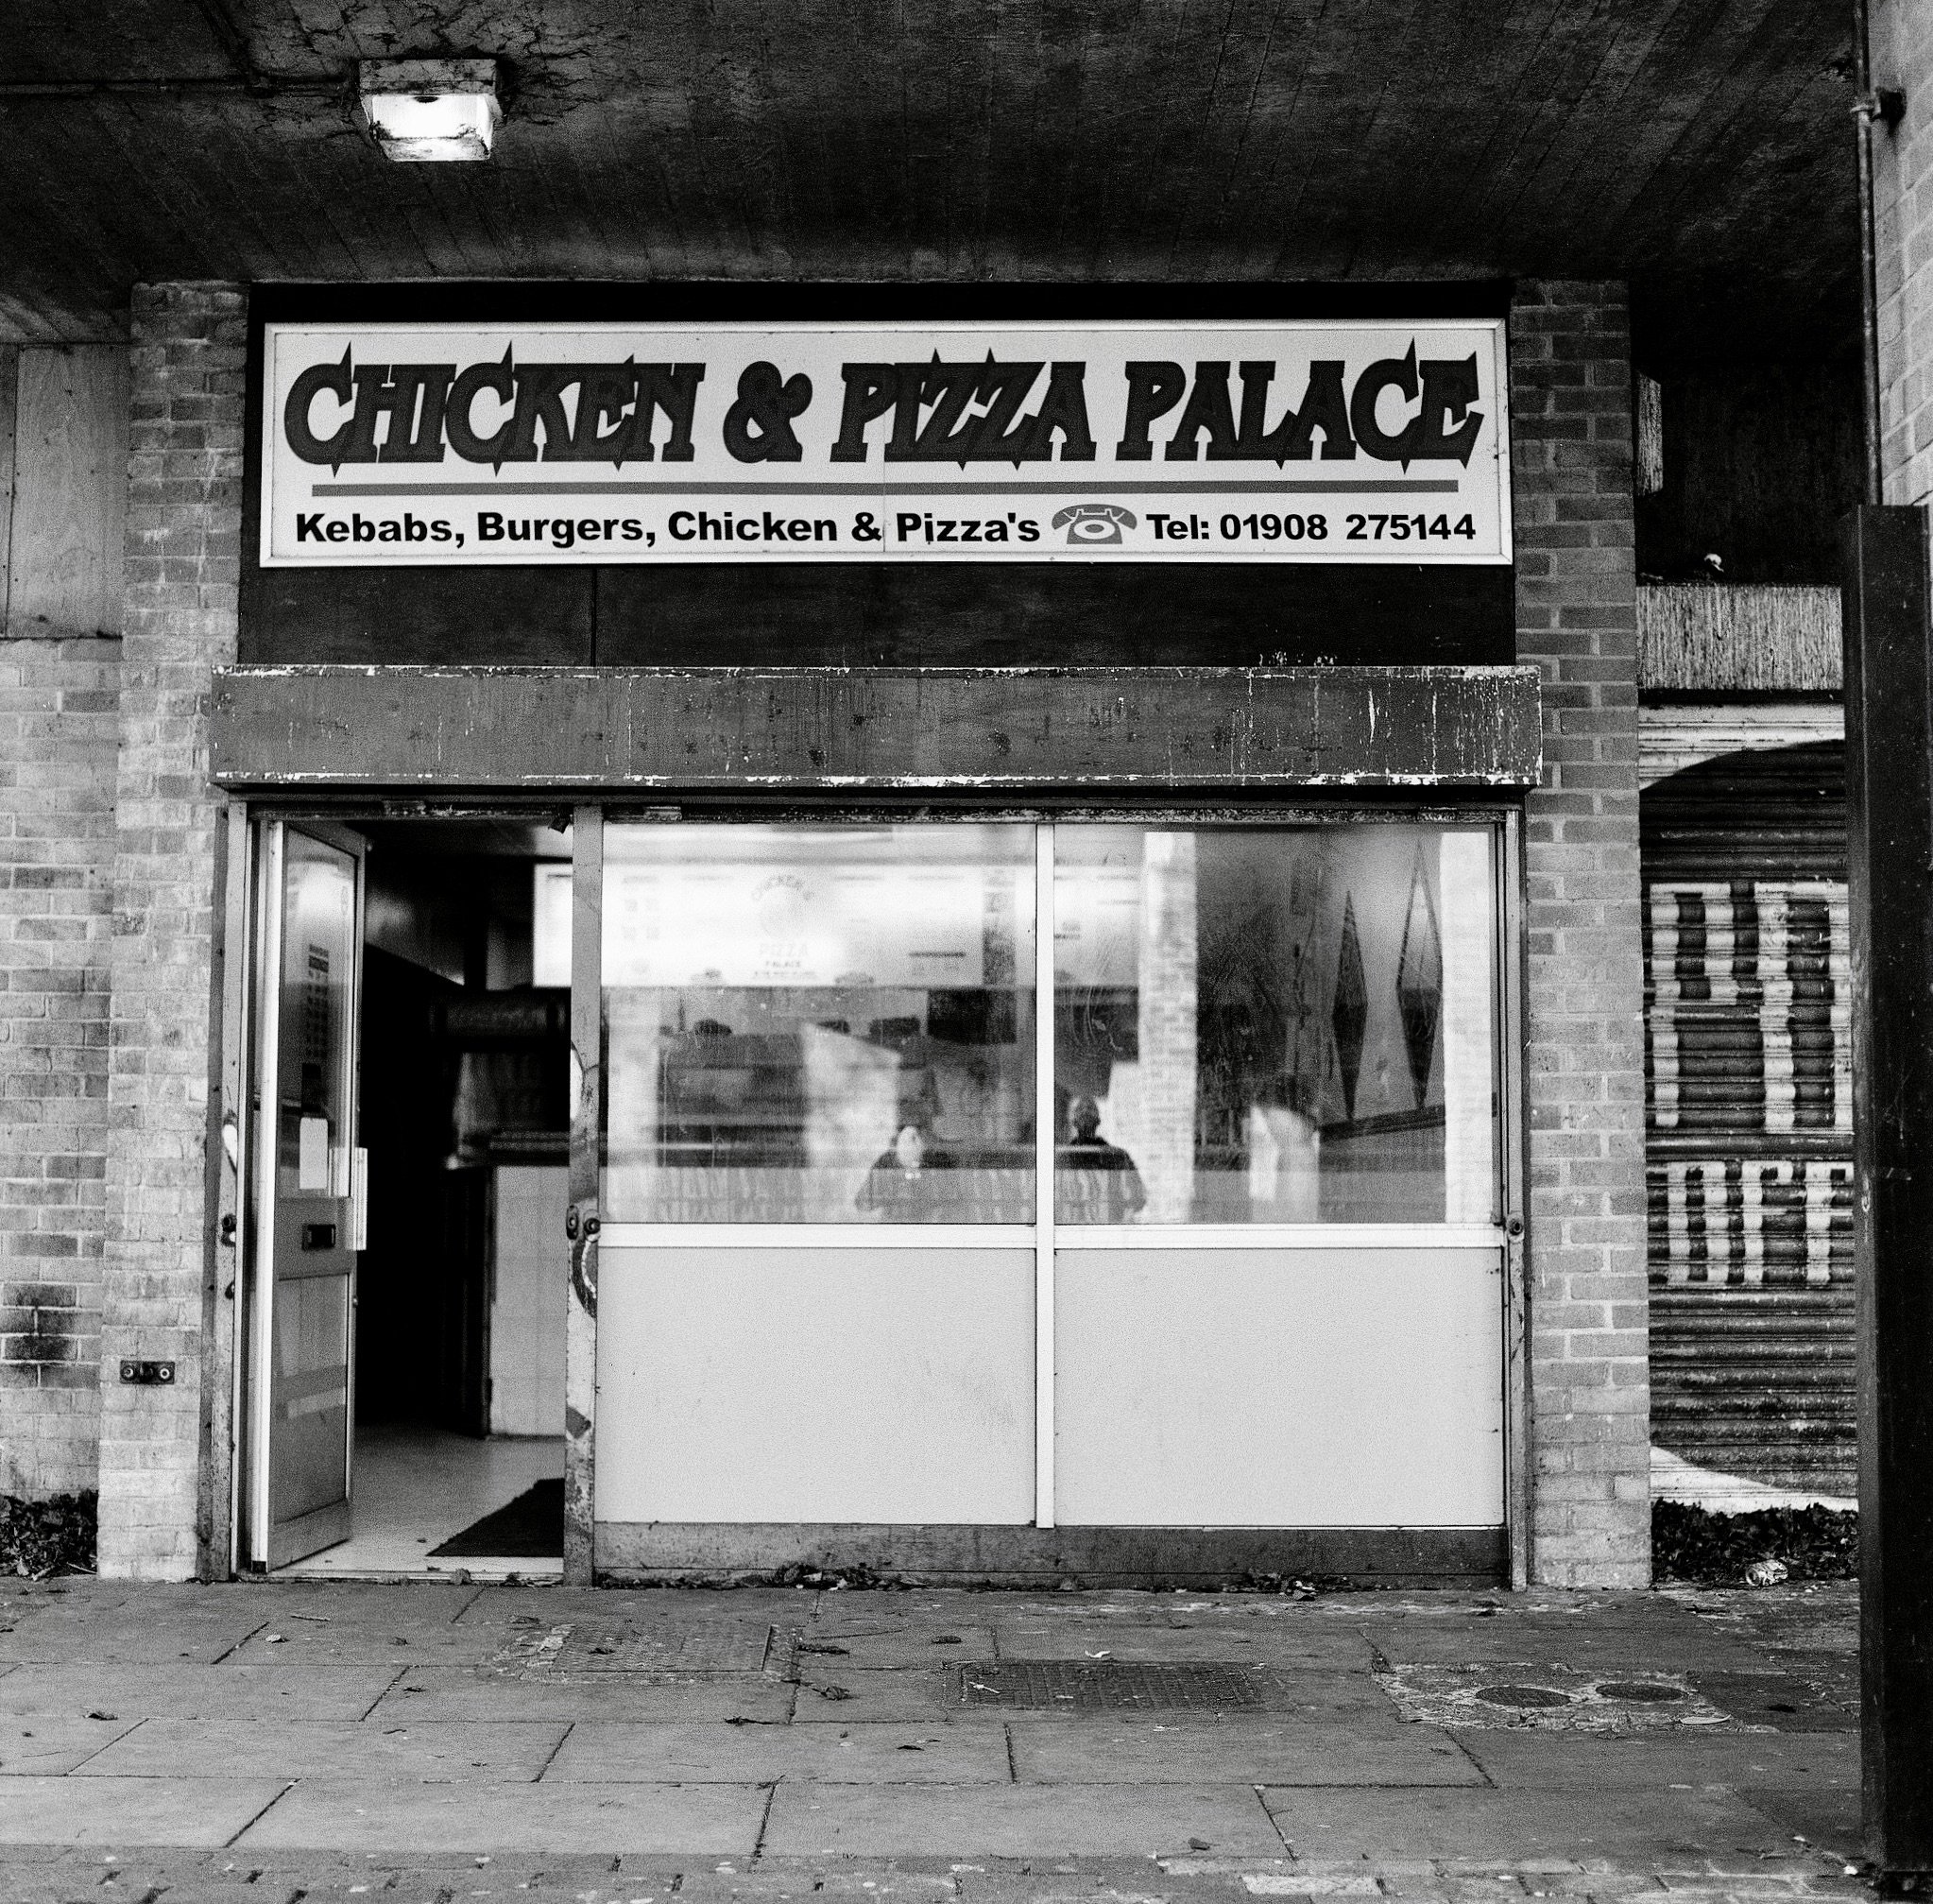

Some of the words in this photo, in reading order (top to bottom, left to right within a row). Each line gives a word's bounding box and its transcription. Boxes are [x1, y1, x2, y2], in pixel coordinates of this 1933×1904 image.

[284, 340, 707, 477] CHICKEN
[723, 361, 813, 464] &
[830, 348, 1097, 471] PIZZA
[1116, 337, 1484, 472] PALACE
[297, 512, 465, 548] Kebabs,
[477, 511, 656, 549] Burgers,
[668, 510, 837, 541] Chicken
[851, 511, 882, 541] &
[897, 511, 1040, 543] Pizza's
[1146, 513, 1210, 540] Tel:
[1220, 513, 1328, 540] 01908
[1345, 513, 1476, 540] 275144
